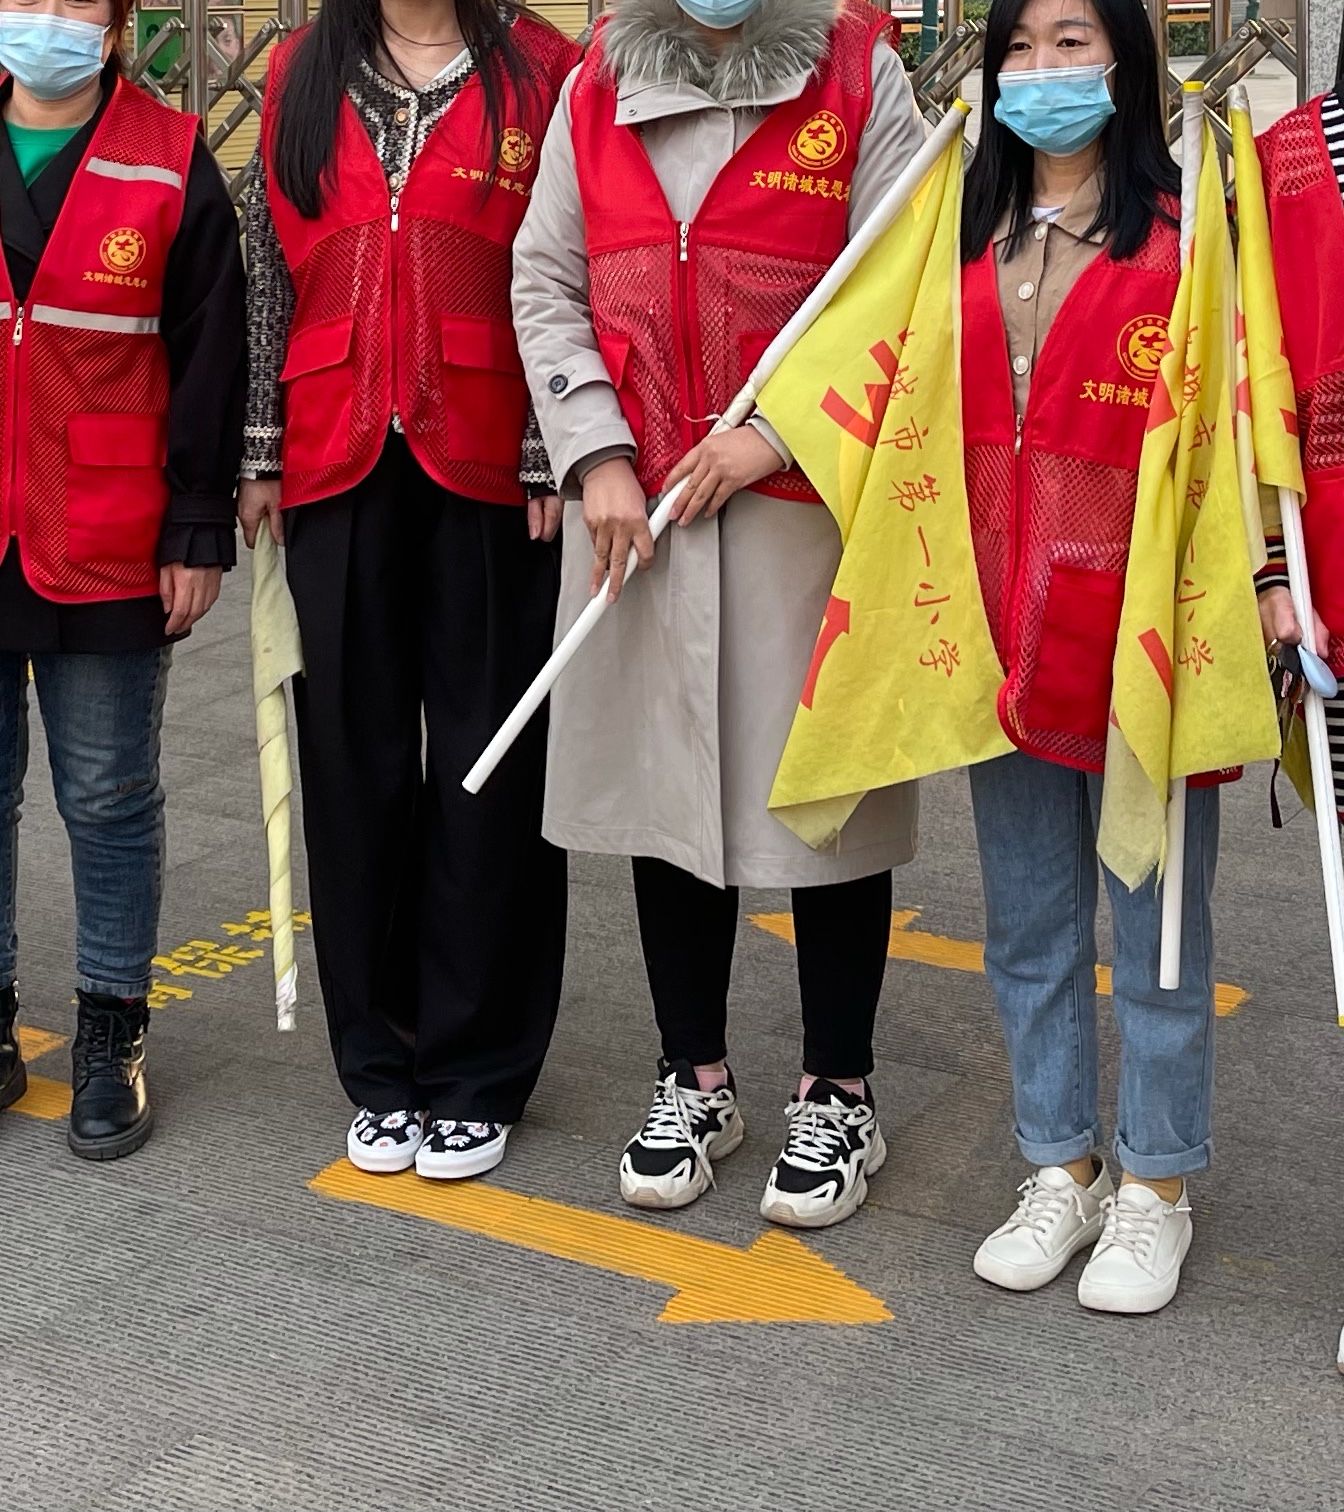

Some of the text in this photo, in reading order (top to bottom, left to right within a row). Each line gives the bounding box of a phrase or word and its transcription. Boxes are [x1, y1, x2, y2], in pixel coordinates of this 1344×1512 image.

[879, 327, 962, 679] 城市第一小学
